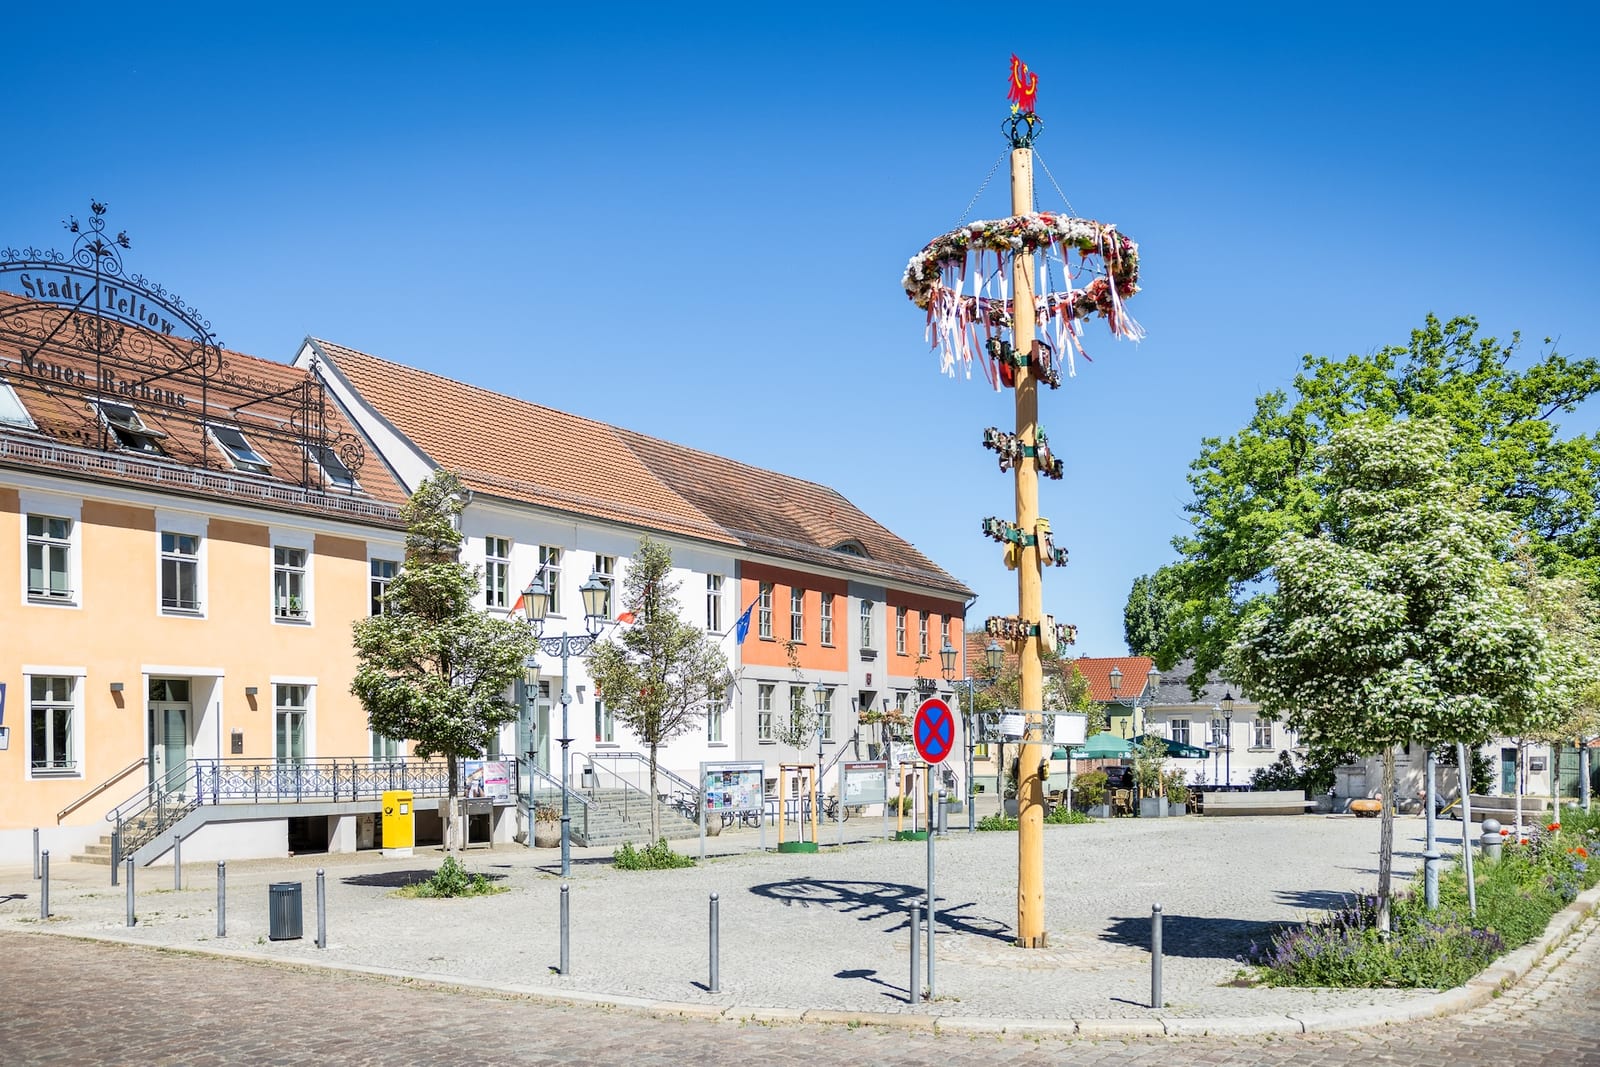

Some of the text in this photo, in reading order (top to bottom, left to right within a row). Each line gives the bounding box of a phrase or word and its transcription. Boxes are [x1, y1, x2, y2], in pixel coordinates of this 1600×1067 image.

[20, 273, 175, 335] Stadt Teltow
[20, 350, 187, 408] Neues Rathaus
